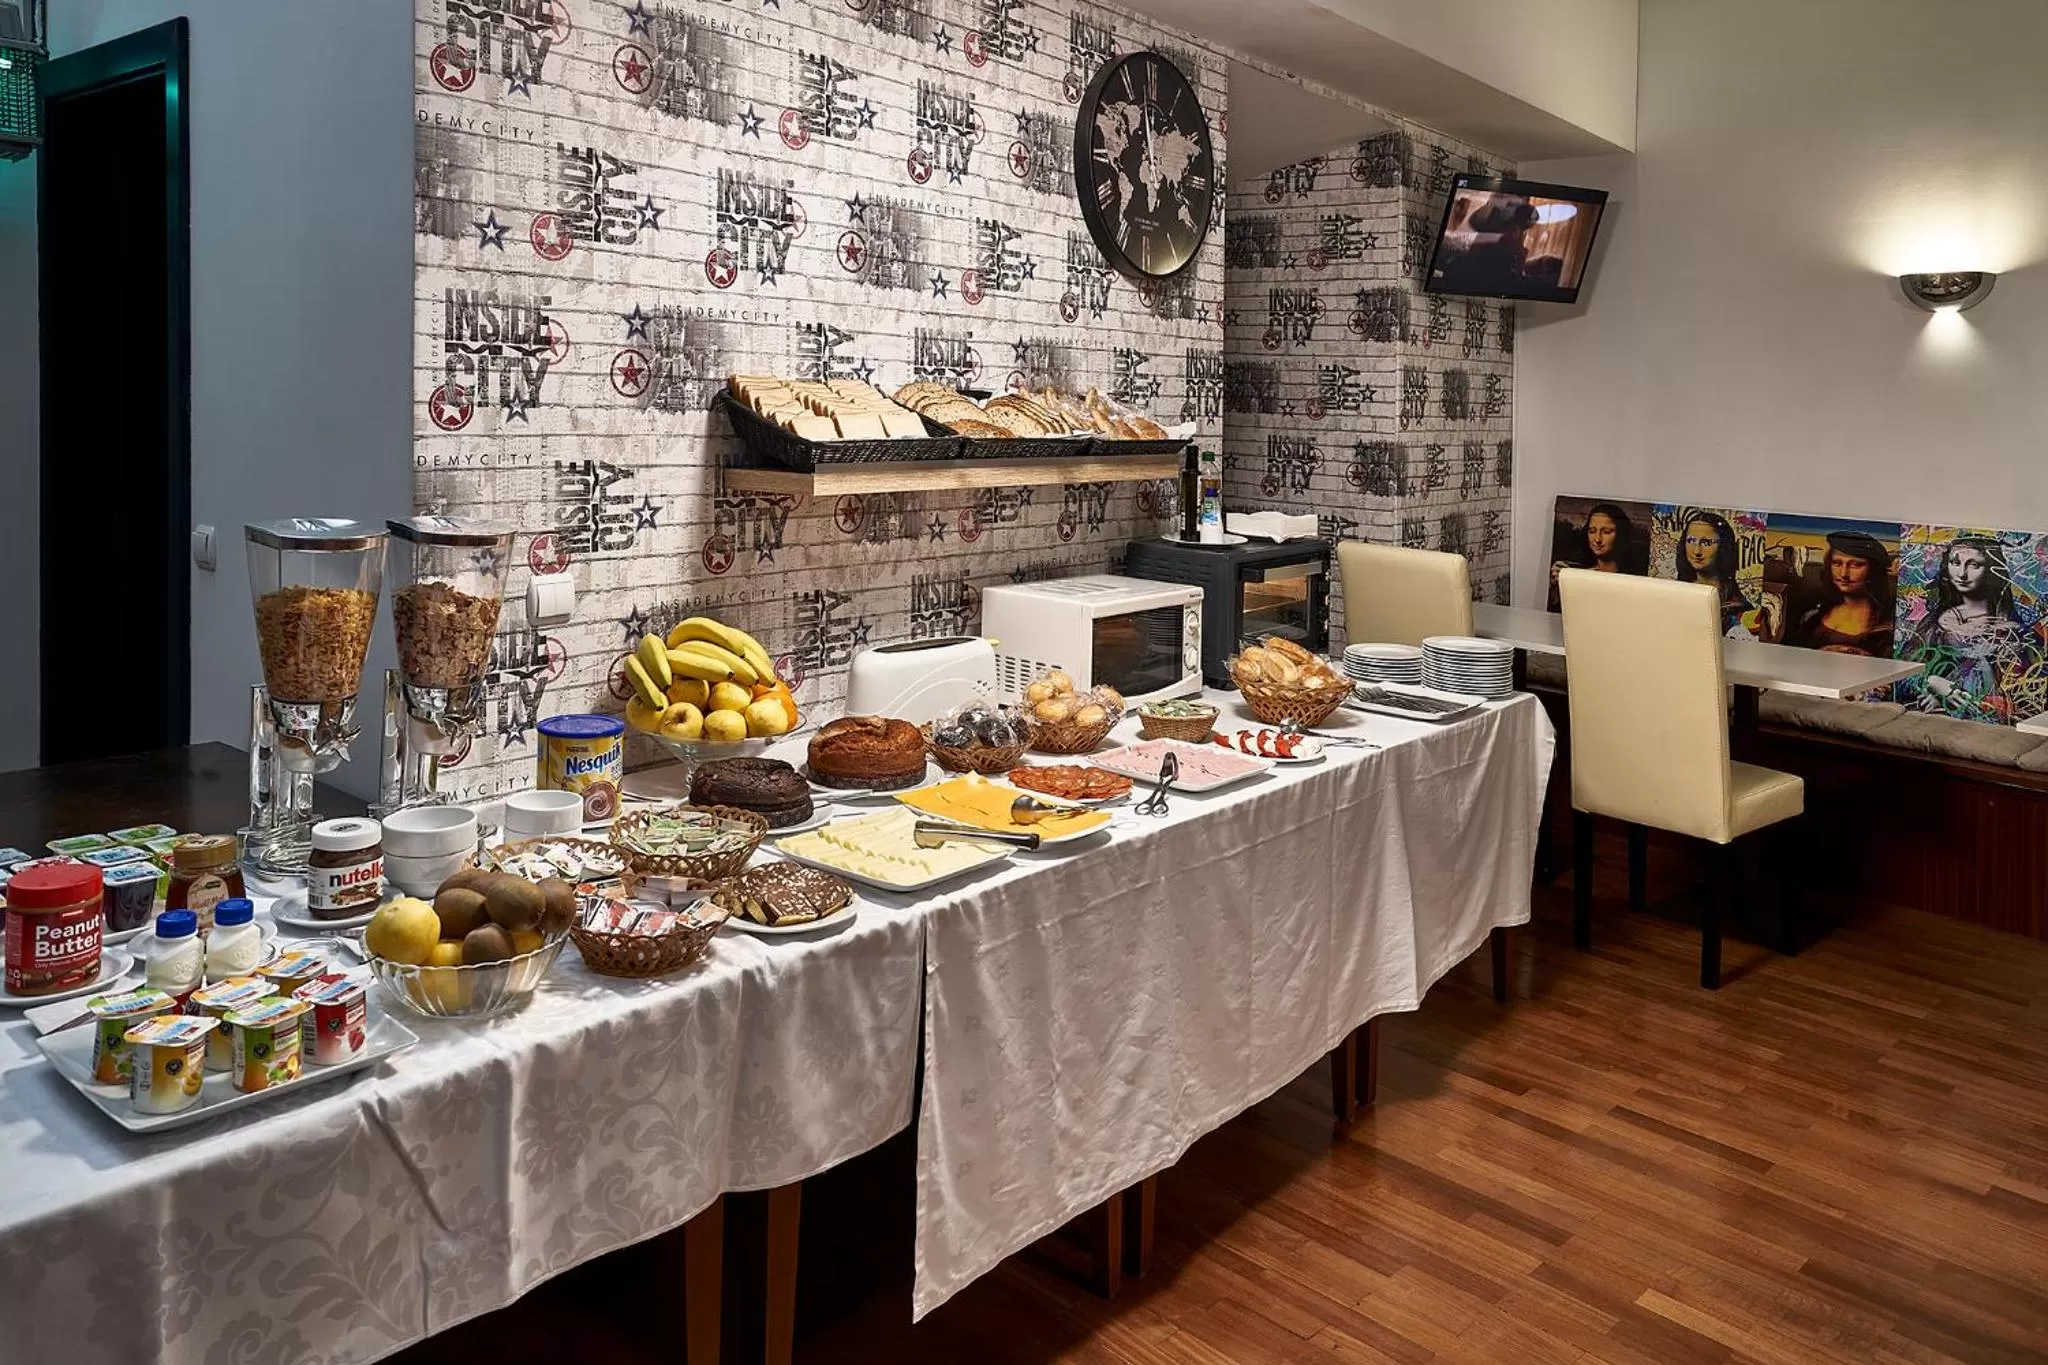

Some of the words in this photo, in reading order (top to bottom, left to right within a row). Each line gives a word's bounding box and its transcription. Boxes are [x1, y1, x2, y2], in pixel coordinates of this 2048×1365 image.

[798, 49, 825, 136] INSIDE
[831, 58, 858, 140] CITY
[916, 78, 976, 130] INSIDE
[917, 127, 975, 175] CITY
[556, 142, 594, 241] INSIDE
[601, 152, 637, 245] CITY
[717, 166, 795, 222] INSIDE
[717, 223, 794, 275] CITY
[976, 217, 998, 289] INSIDE
[1001, 221, 1022, 292] CITY
[445, 287, 552, 345] INSIDE
[1269, 288, 1319, 312] INSIDE
[914, 327, 973, 368] INSIDE
[1269, 315, 1318, 341] CITY
[445, 352, 551, 408] CITY
[417, 454, 532, 467] DEMYCITY
[1267, 434, 1316, 459] INSIDE
[1267, 463, 1316, 488] CITY
[555, 460, 591, 554] INSIDE
[599, 460, 634, 550] CITY
[714, 504, 791, 553] CITY
[911, 569, 970, 613] INSIDE
[793, 589, 820, 671] INSIDE
[825, 589, 852, 667] CITY
[566, 741, 620, 775] Nesquik
[35, 931, 99, 957] Butter
[36, 914, 100, 940] Peanut
